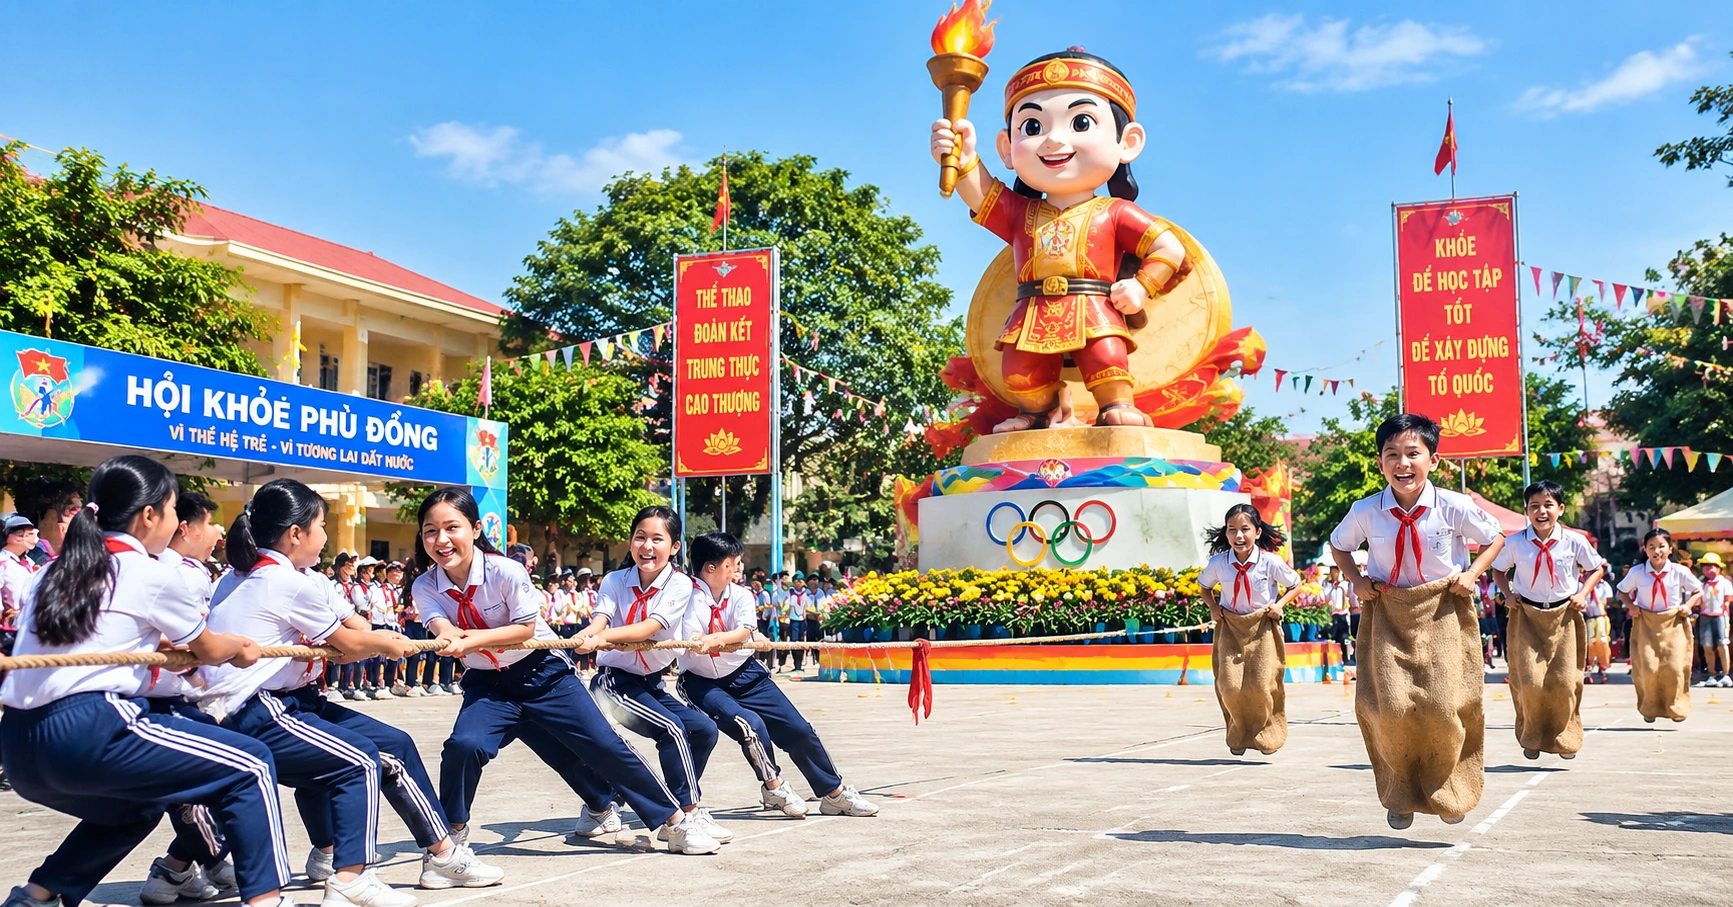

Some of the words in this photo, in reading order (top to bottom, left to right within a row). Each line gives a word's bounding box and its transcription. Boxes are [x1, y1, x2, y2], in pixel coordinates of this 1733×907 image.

[1437, 270, 1469, 294] HỌC
[1472, 264, 1503, 292] TẬP
[721, 287, 752, 307] THAO
[1443, 297, 1473, 324] TỐT
[730, 315, 753, 341] KẾT
[686, 357, 725, 379] TRUNG
[728, 354, 760, 380] THỰC
[685, 394, 709, 415] CAO
[712, 389, 760, 416] THƯỢNG
[300, 404, 358, 438] PHÙ
[168, 424, 185, 440] VÌ
[219, 430, 239, 452] HỆ
[295, 443, 337, 460] TƯƠNG
[339, 449, 359, 463] LAI
[384, 454, 414, 470] NƯỚC
